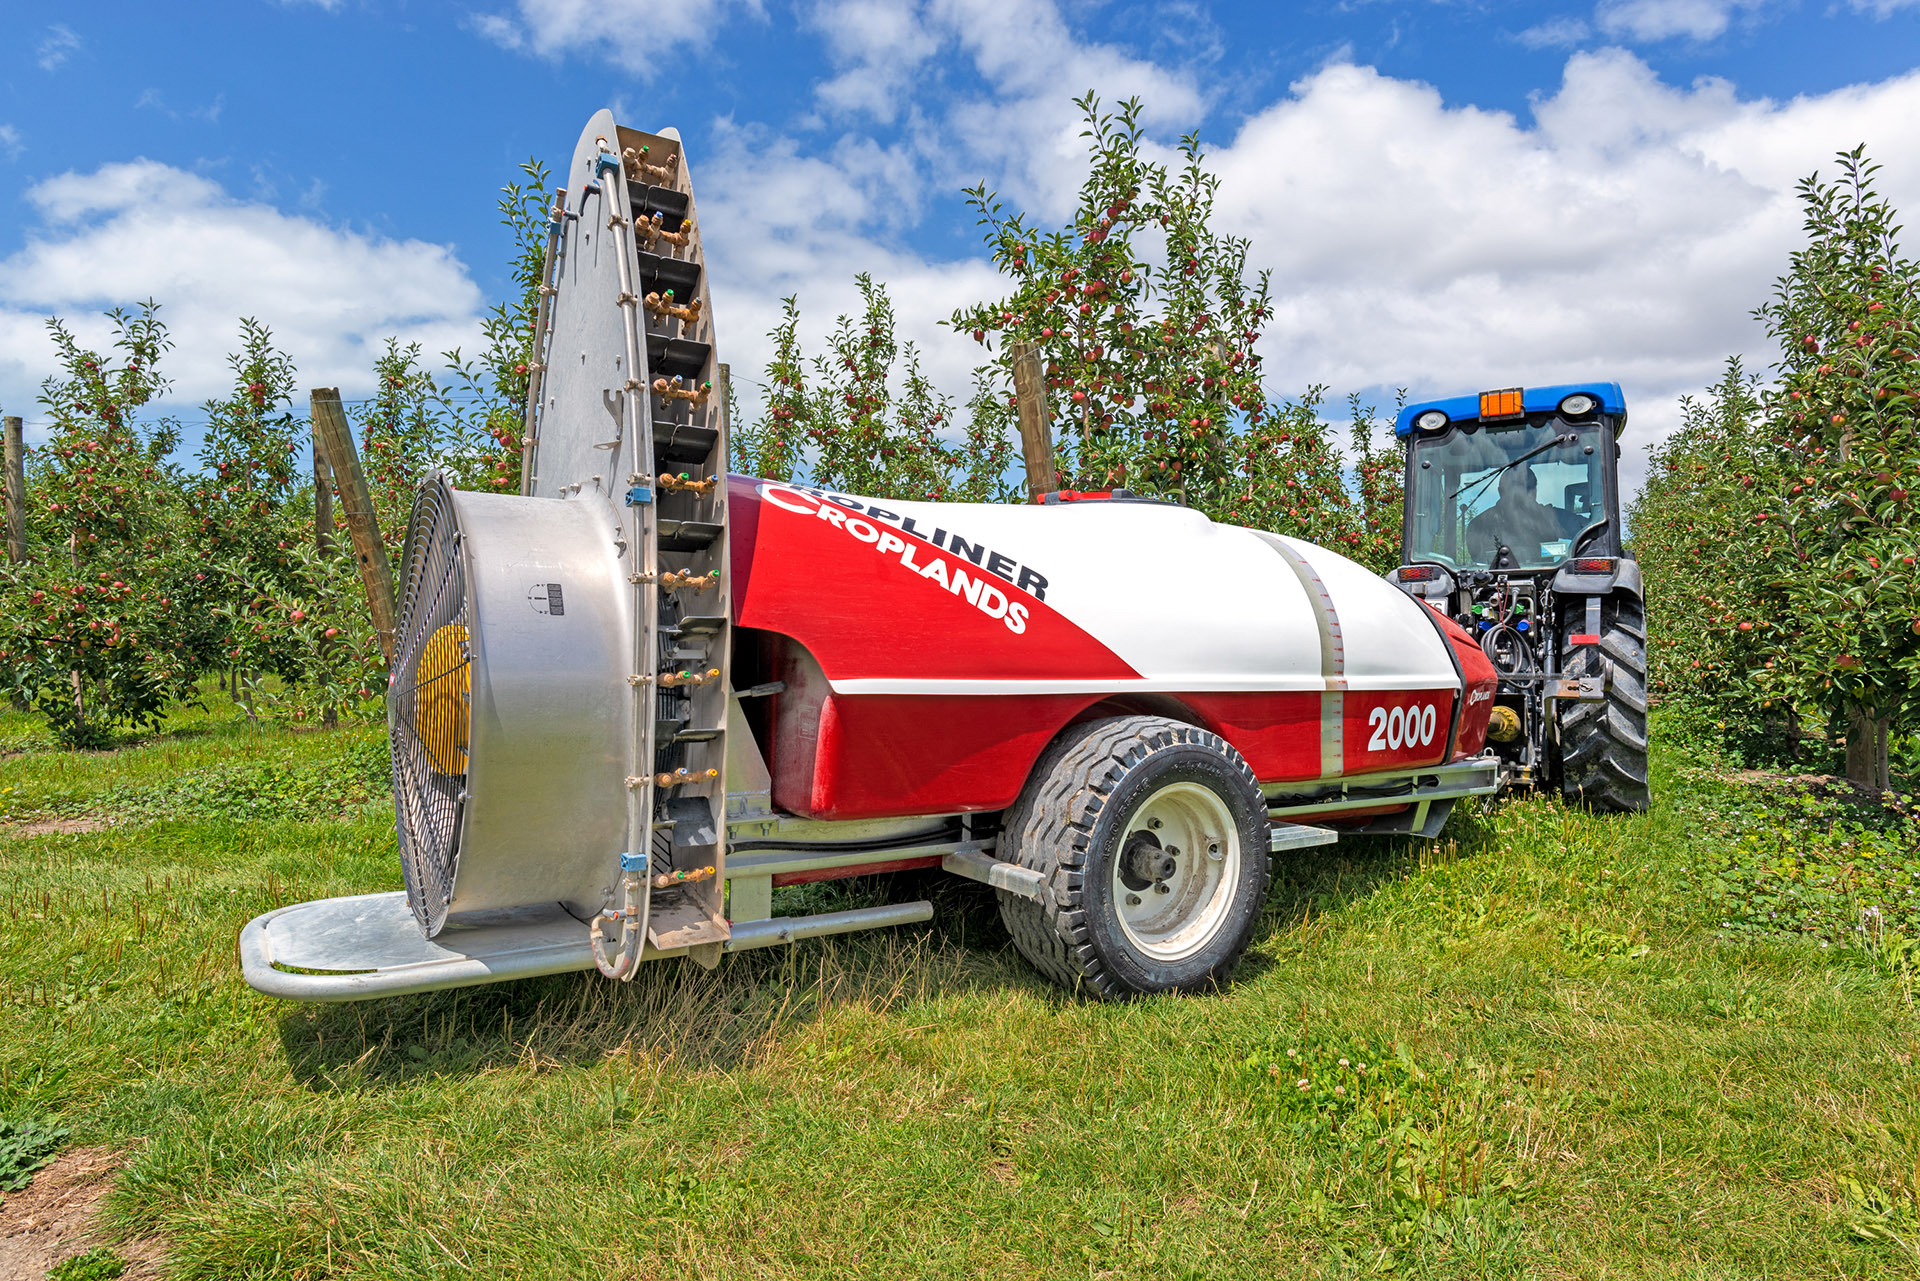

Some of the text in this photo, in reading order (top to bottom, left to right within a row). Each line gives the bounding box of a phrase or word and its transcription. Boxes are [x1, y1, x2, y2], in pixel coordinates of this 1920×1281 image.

[754, 484, 1029, 634] CROPLANDS
[766, 480, 1049, 602] OPLINER
[1368, 704, 1436, 751] 2000
